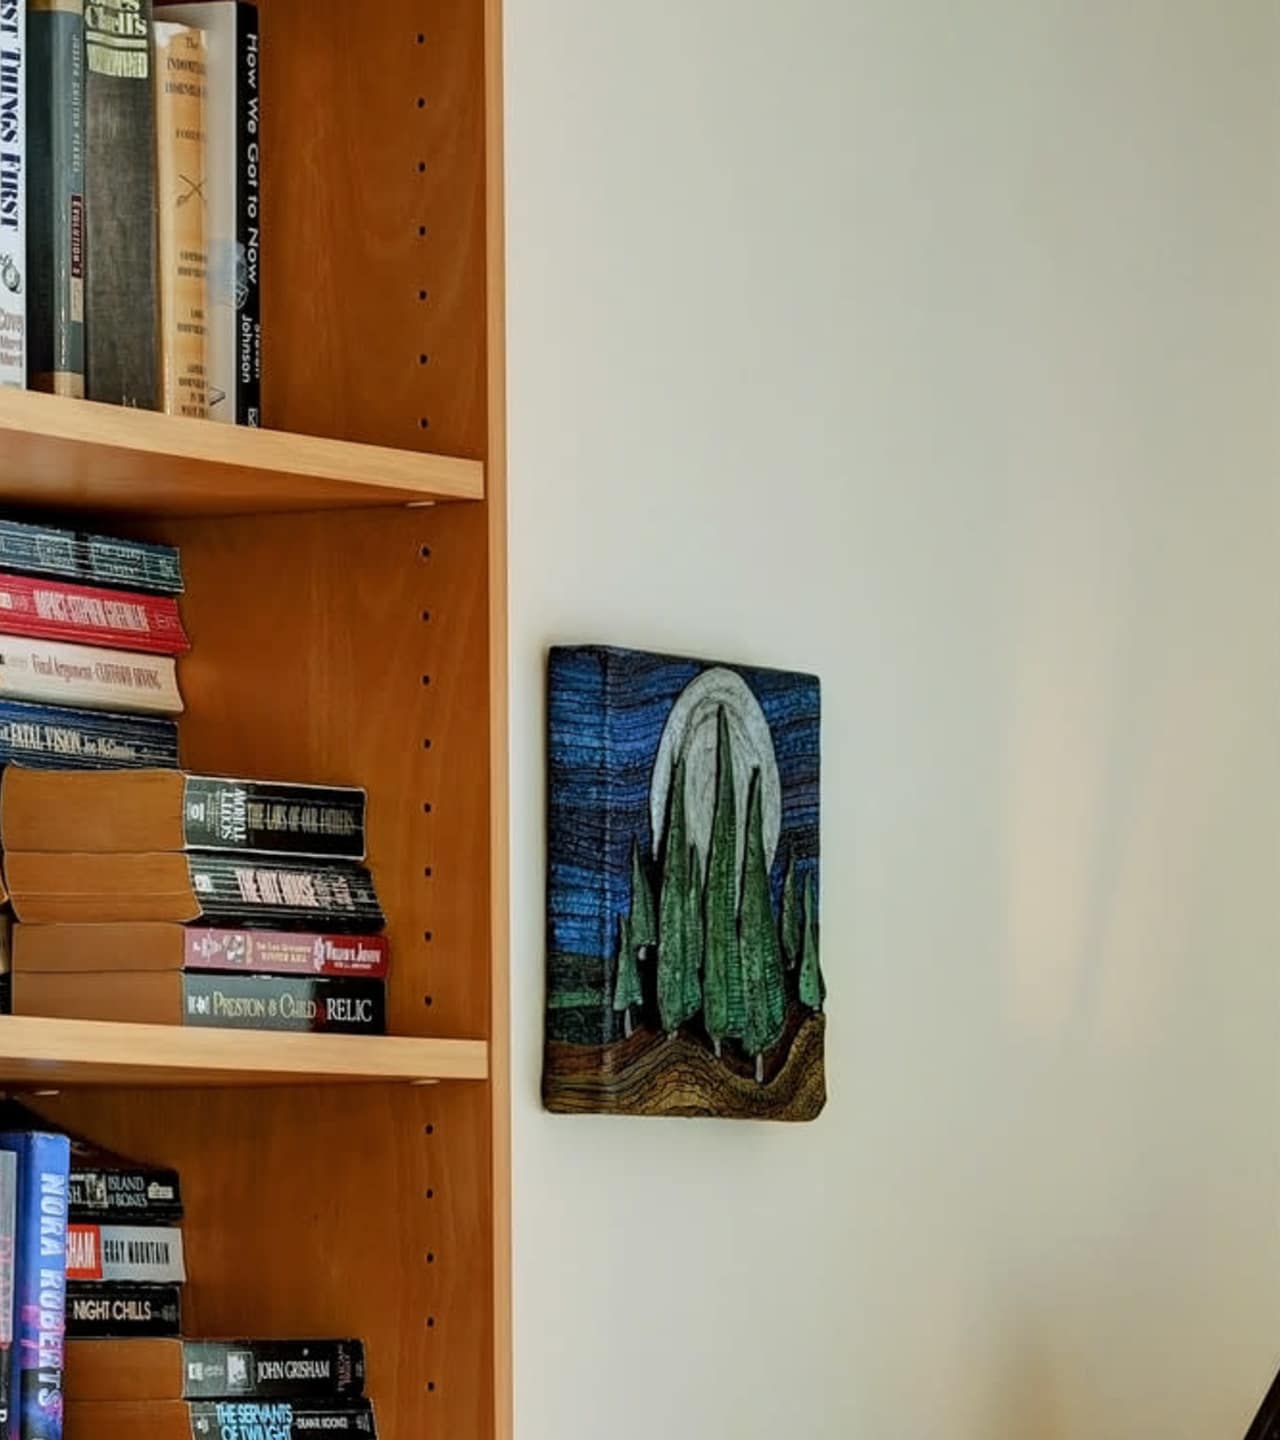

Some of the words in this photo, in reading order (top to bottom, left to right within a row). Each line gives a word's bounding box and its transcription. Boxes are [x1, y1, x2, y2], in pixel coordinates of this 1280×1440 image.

[246, 32, 260, 91] How
[0, 46, 21, 144] THINGS
[246, 97, 260, 135] We
[246, 142, 260, 188] Got
[0, 150, 21, 233] FIRST
[246, 194, 260, 219] to
[246, 227, 260, 284] Now
[240, 313, 254, 384] Johnson
[10, 722, 45, 751] FATAL
[44, 725, 81, 754] VISION
[219, 788, 234, 841] SCOTT
[212, 990, 266, 1018] PRESTON
[279, 992, 317, 1018] CHILD
[326, 998, 373, 1022] RELIC
[107, 1176, 145, 1192] ISLAND
[115, 1193, 158, 1208] BONES
[39, 1173, 66, 1257] NORA
[103, 1239, 125, 1264] GRAY
[127, 1240, 171, 1265] MOUNTAIN
[72, 1299, 111, 1321] NIGHT
[111, 1299, 162, 1321] CHILLS
[37, 1268, 65, 1406] ROBERTS
[256, 1361, 284, 1383] JOHN
[284, 1360, 331, 1380] GRISHAM
[216, 1402, 237, 1424] THE
[238, 1402, 293, 1424] SERVANTS
